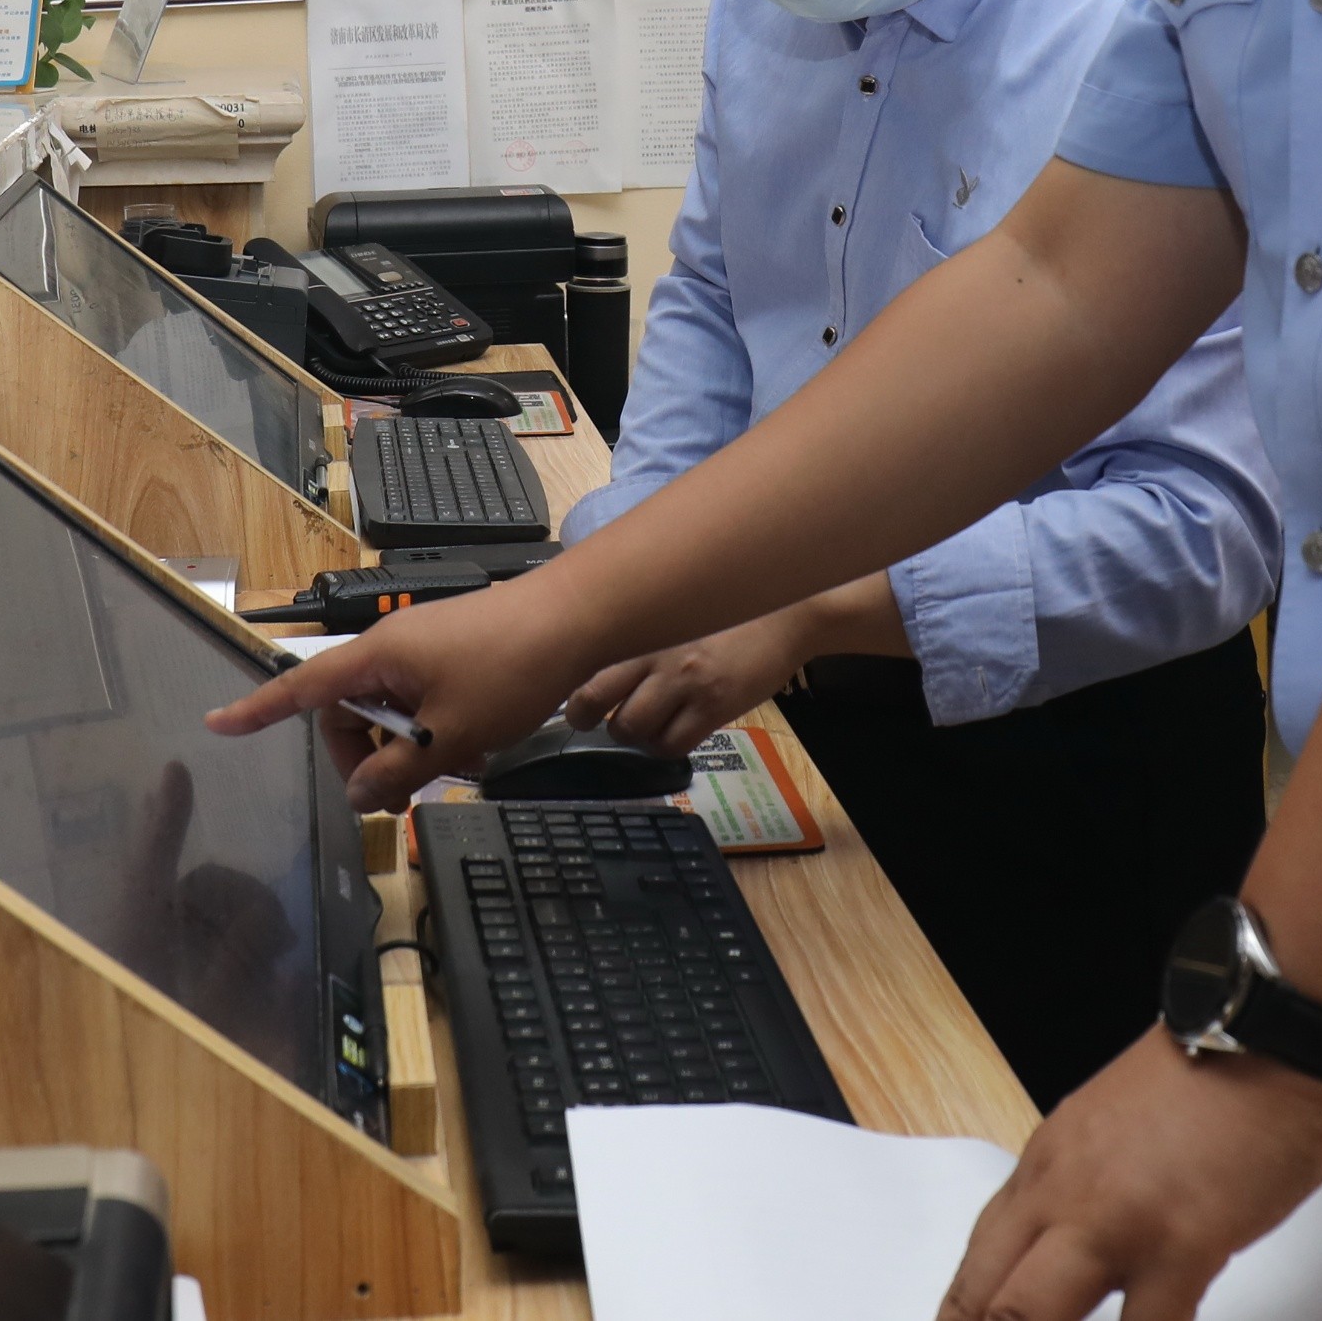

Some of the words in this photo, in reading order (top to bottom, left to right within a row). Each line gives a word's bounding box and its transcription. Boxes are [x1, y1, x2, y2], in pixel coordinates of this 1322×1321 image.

[330, 21, 439, 45] 济南市长清区发展和改革局文件
